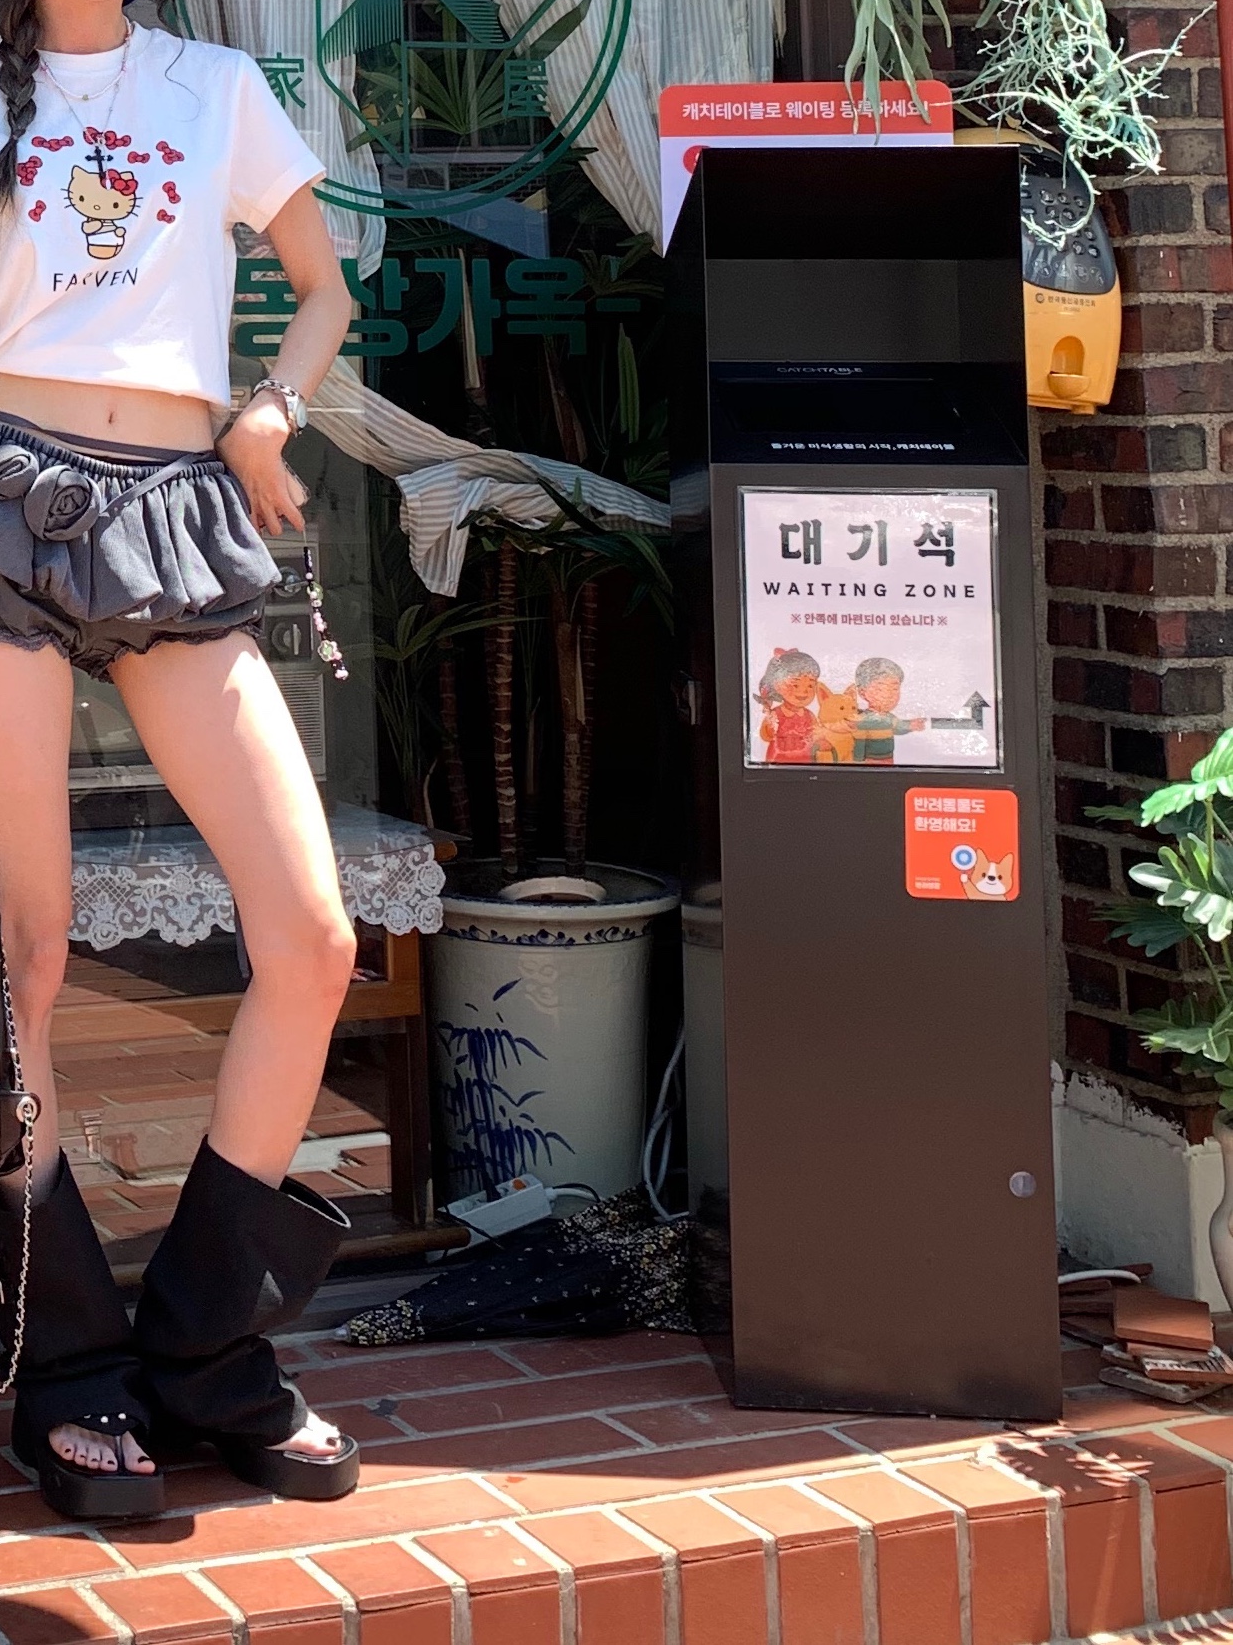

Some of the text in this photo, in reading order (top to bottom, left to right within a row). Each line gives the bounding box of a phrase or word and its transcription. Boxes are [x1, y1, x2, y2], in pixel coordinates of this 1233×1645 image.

[682, 101, 783, 121] 캐치테이블로
[785, 100, 836, 120] 웨이팅
[778, 518, 957, 568] 대기석
[763, 581, 976, 599] WAITING ZONE
[803, 612, 839, 626] 안쪽에
[840, 613, 887, 627] 마련되어
[889, 613, 935, 627] 있습니다
[913, 796, 986, 814] 반려동물도
[913, 816, 977, 833] 환영해요!
